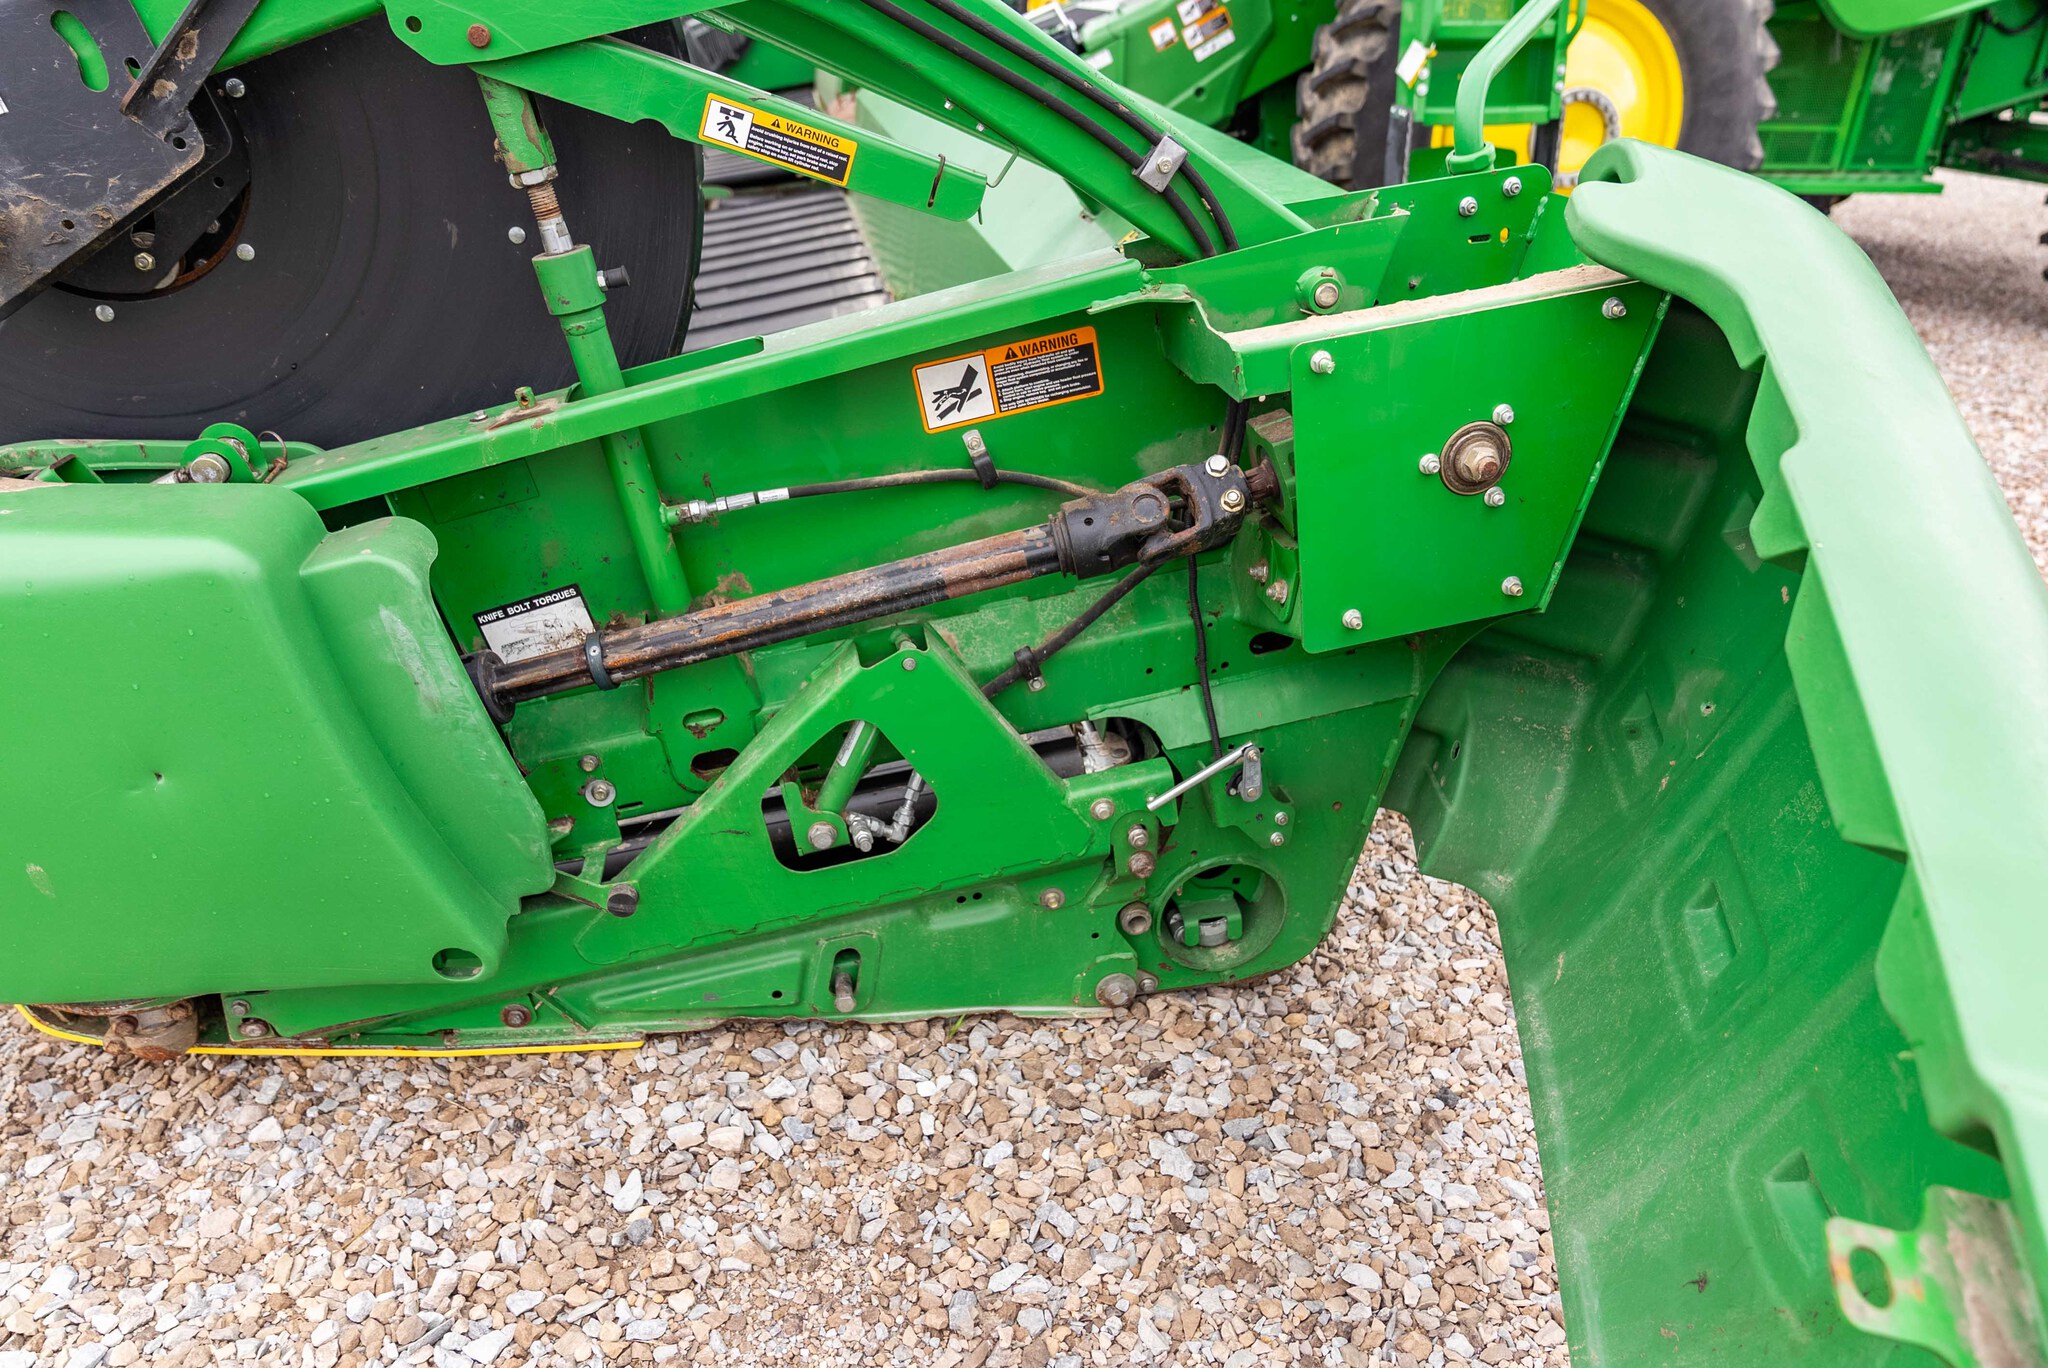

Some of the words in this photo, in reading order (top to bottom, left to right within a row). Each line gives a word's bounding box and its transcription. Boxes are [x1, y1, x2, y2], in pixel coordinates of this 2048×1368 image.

[786, 122, 840, 148] WARNING
[1019, 333, 1078, 356] WARNING
[478, 610, 504, 624] KNIFE
[507, 601, 531, 615] BOLT
[532, 588, 577, 607] TORQUES
